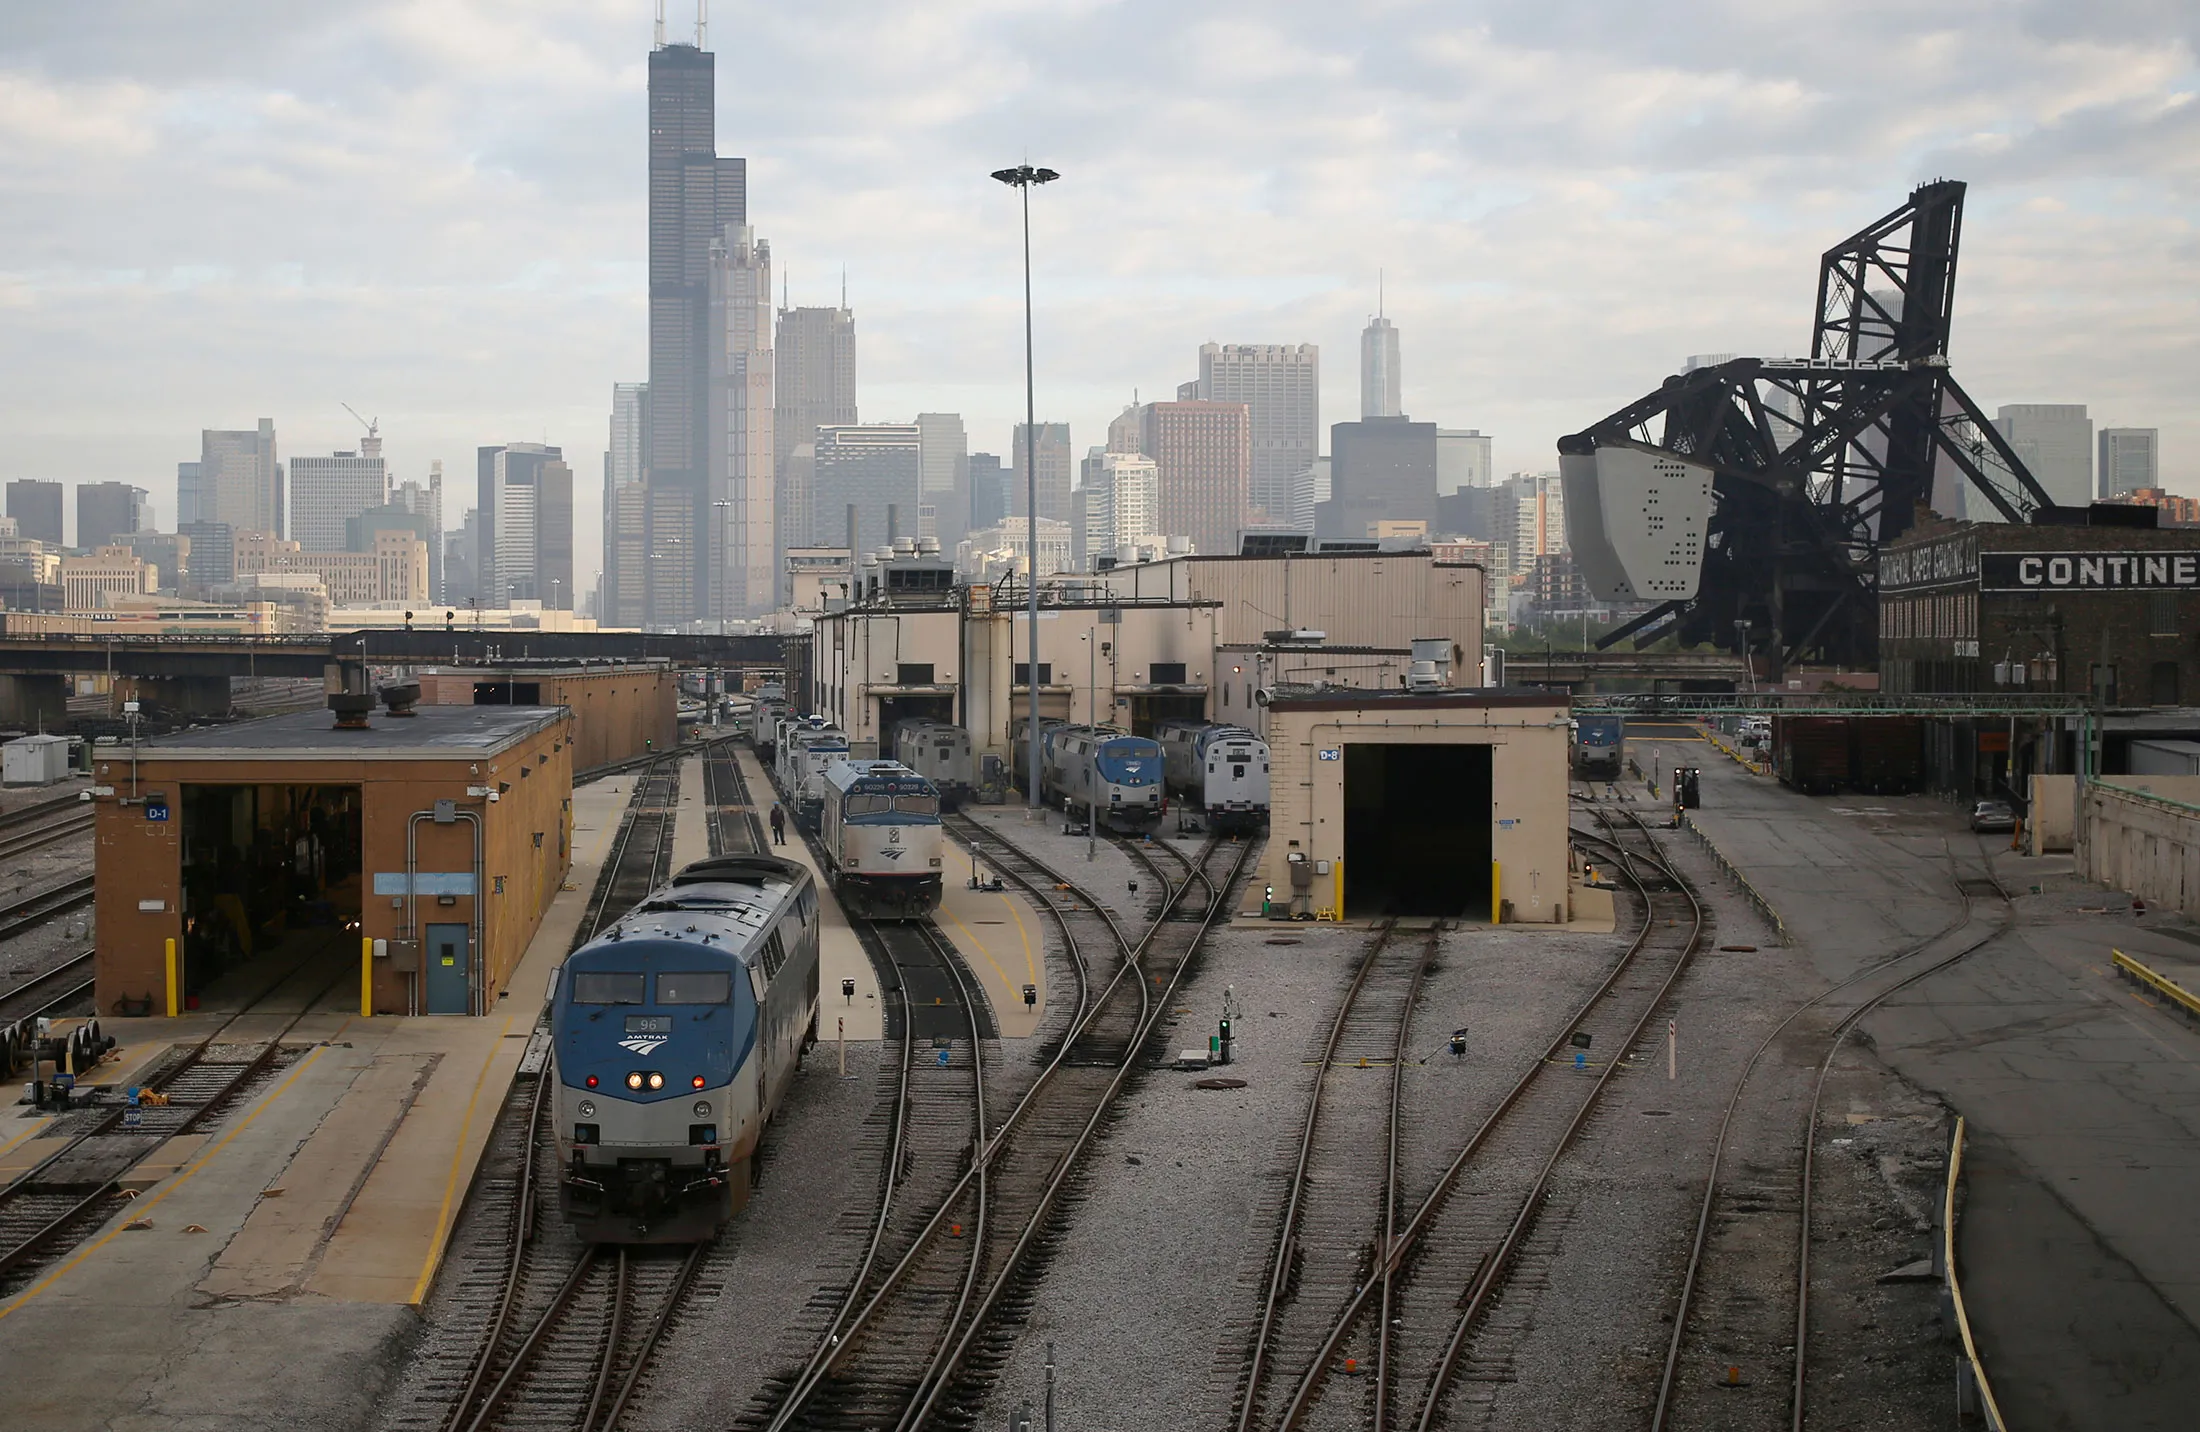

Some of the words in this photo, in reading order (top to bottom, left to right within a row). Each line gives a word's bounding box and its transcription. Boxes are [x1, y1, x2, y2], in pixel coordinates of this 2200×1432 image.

[1912, 547, 1932, 582] PAPER
[2019, 557, 2197, 585] CONTINE
[1320, 750, 1338, 760] D-8
[149, 808, 166, 819] D-1
[640, 1019, 657, 1030] 96
[935, 1037, 950, 1045] STOP
[125, 1113, 140, 1122] STOP
